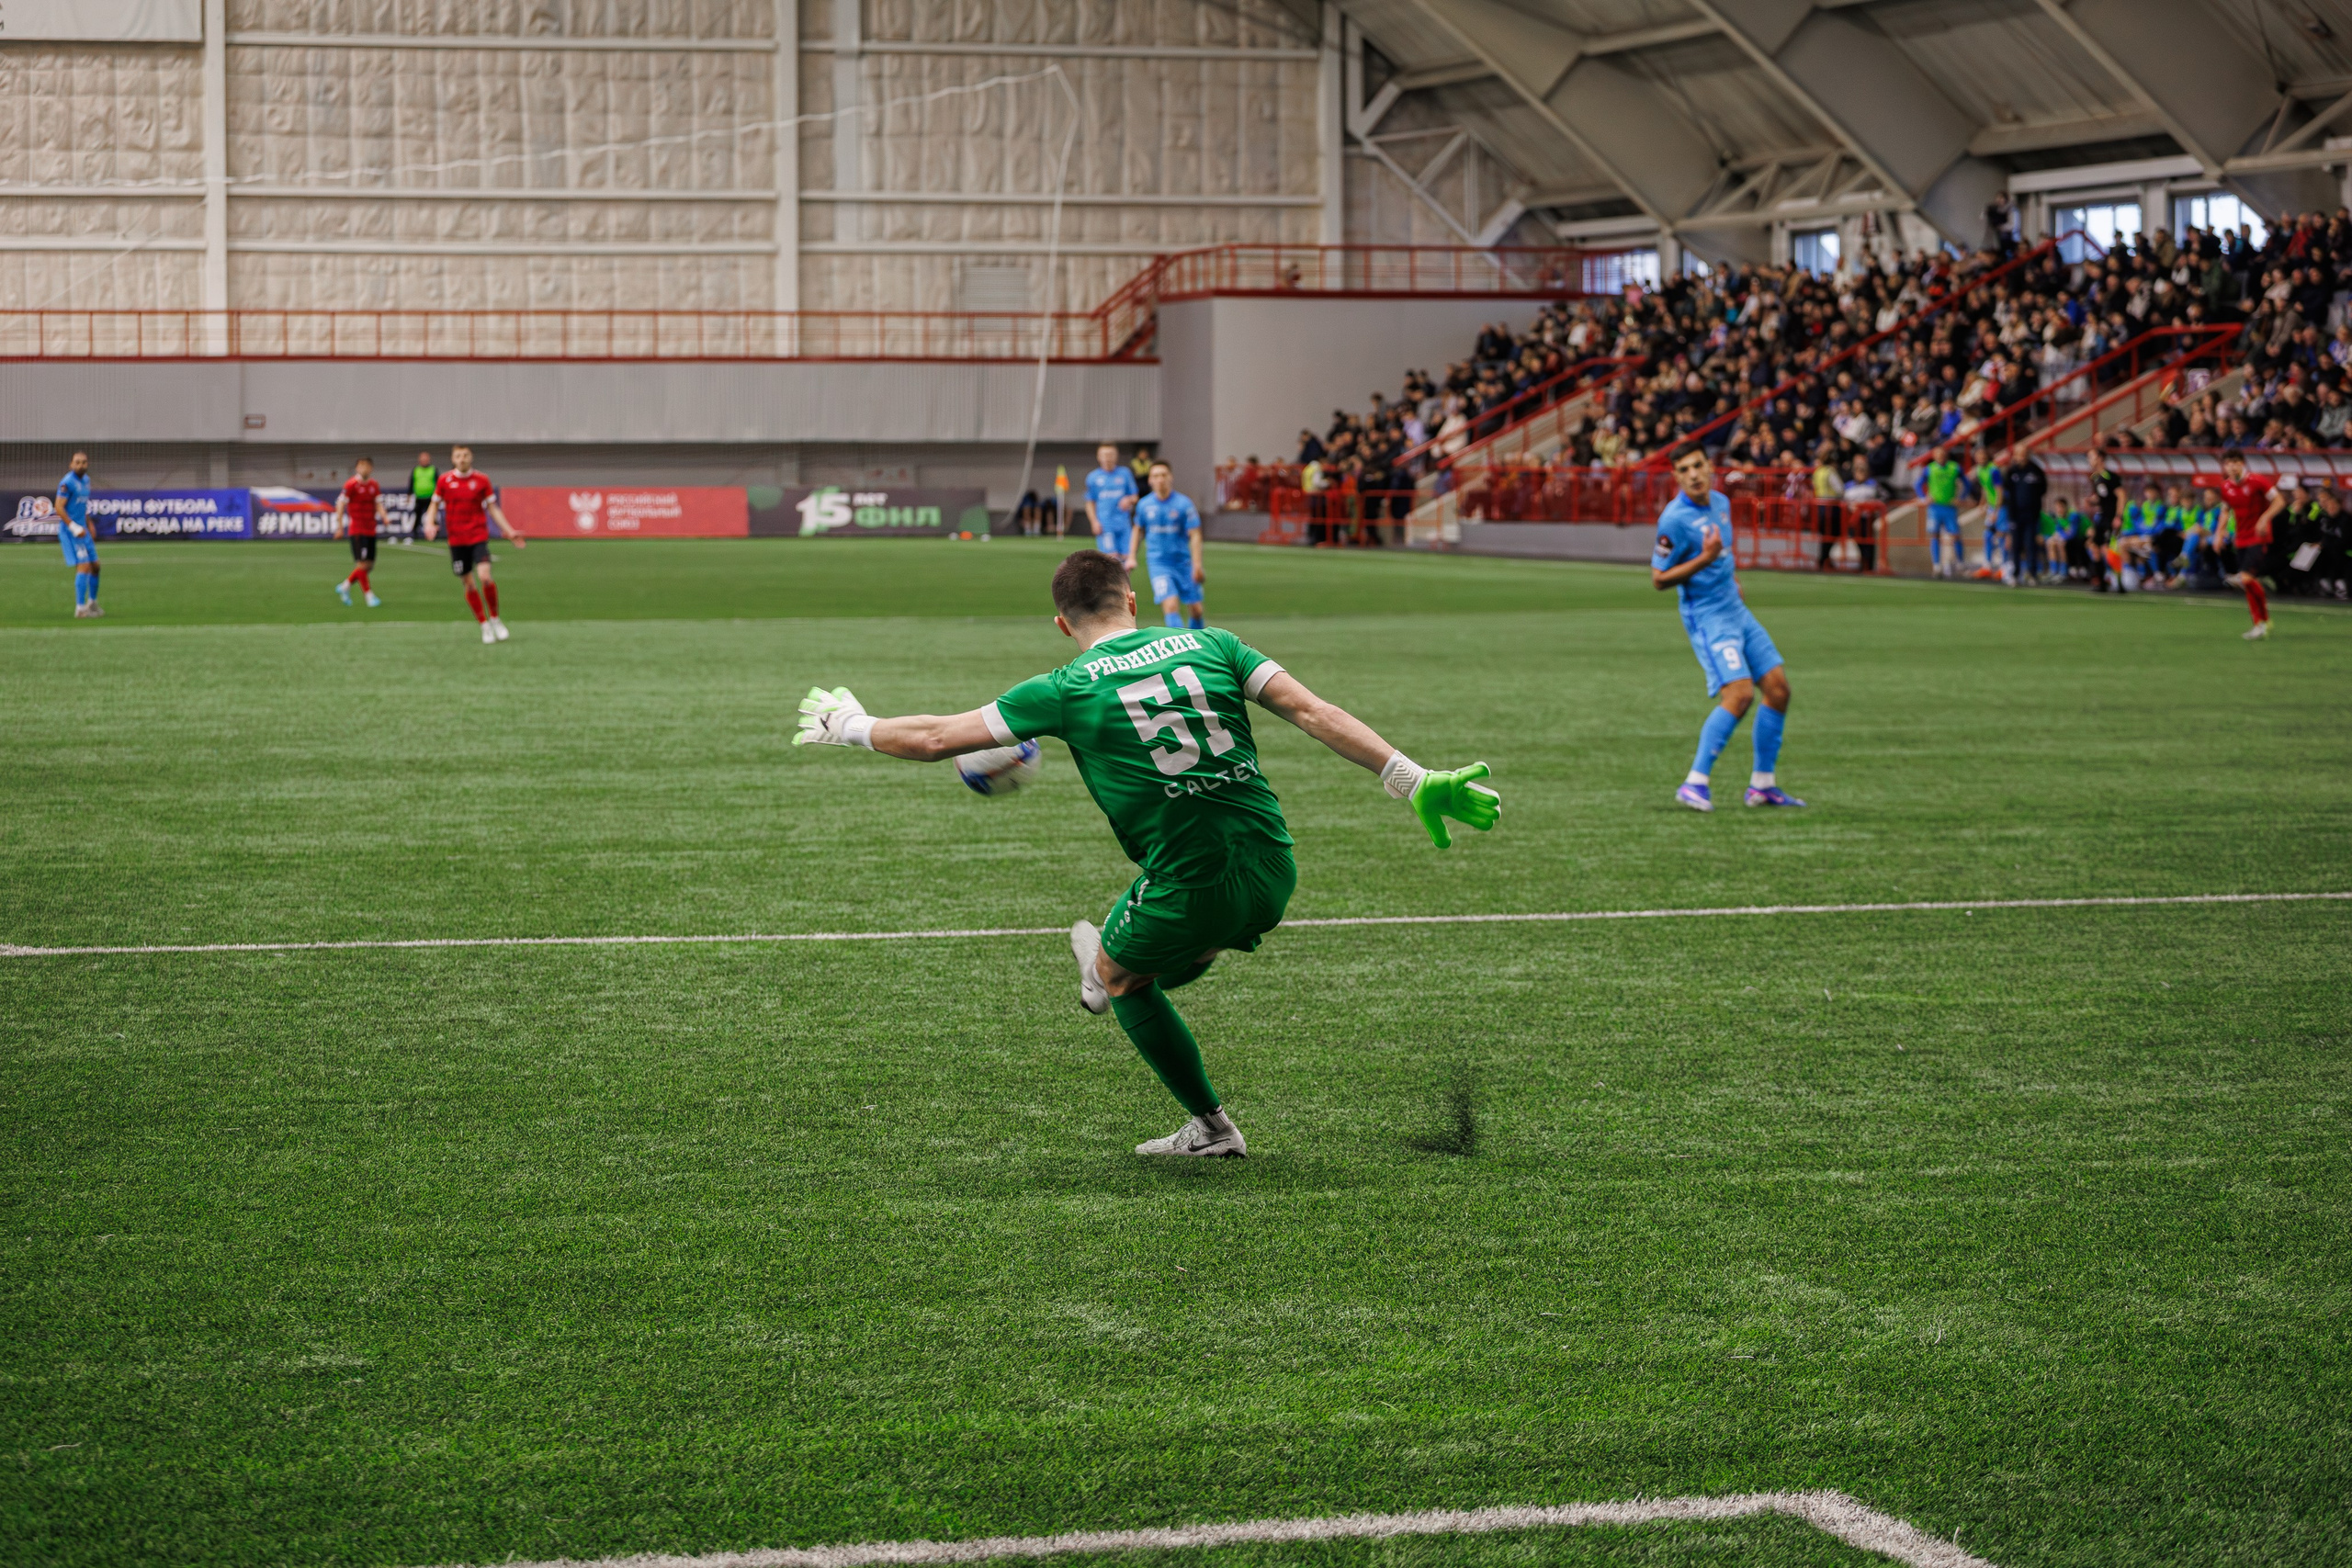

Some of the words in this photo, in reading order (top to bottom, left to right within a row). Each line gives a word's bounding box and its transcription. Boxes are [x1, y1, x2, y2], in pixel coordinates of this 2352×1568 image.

[143, 498, 218, 514] ФУТБОЛА
[796, 491, 853, 530] 15
[116, 516, 181, 535] ГОРОДА
[182, 516, 206, 533] НА
[207, 516, 244, 533] РЕКЕ
[1083, 633, 1203, 682] РЯБИНКИН
[1722, 646, 1742, 671] 9
[1115, 664, 1236, 776] 51
